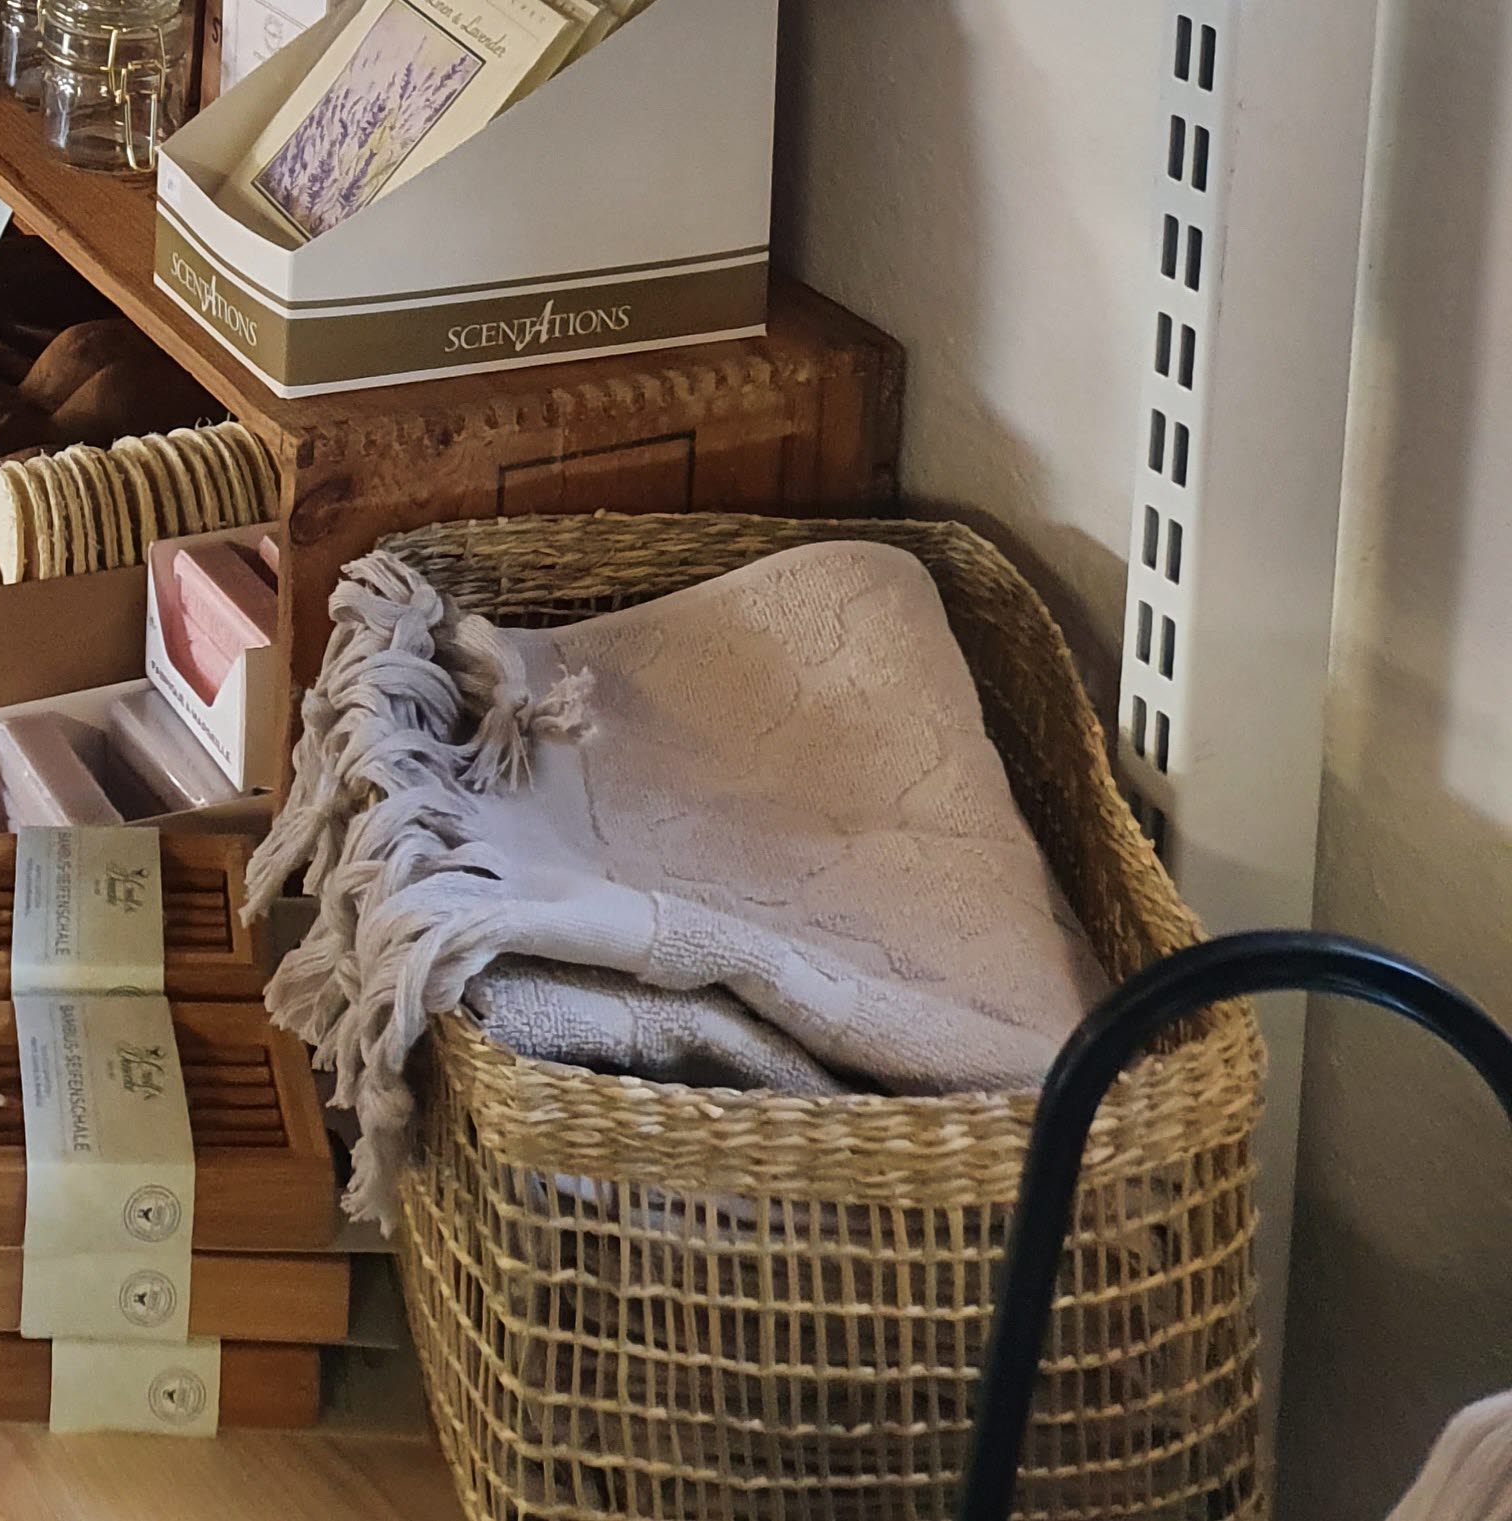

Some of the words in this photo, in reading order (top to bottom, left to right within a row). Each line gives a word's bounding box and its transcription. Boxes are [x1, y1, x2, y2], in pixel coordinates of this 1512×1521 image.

[460, 15, 508, 59] Lavender
[170, 252, 258, 347] SCENTATIONS
[444, 298, 633, 352] SCENTATIONS
[59, 1004, 91, 1153] BAMBUS-SEIFENSCHALE
